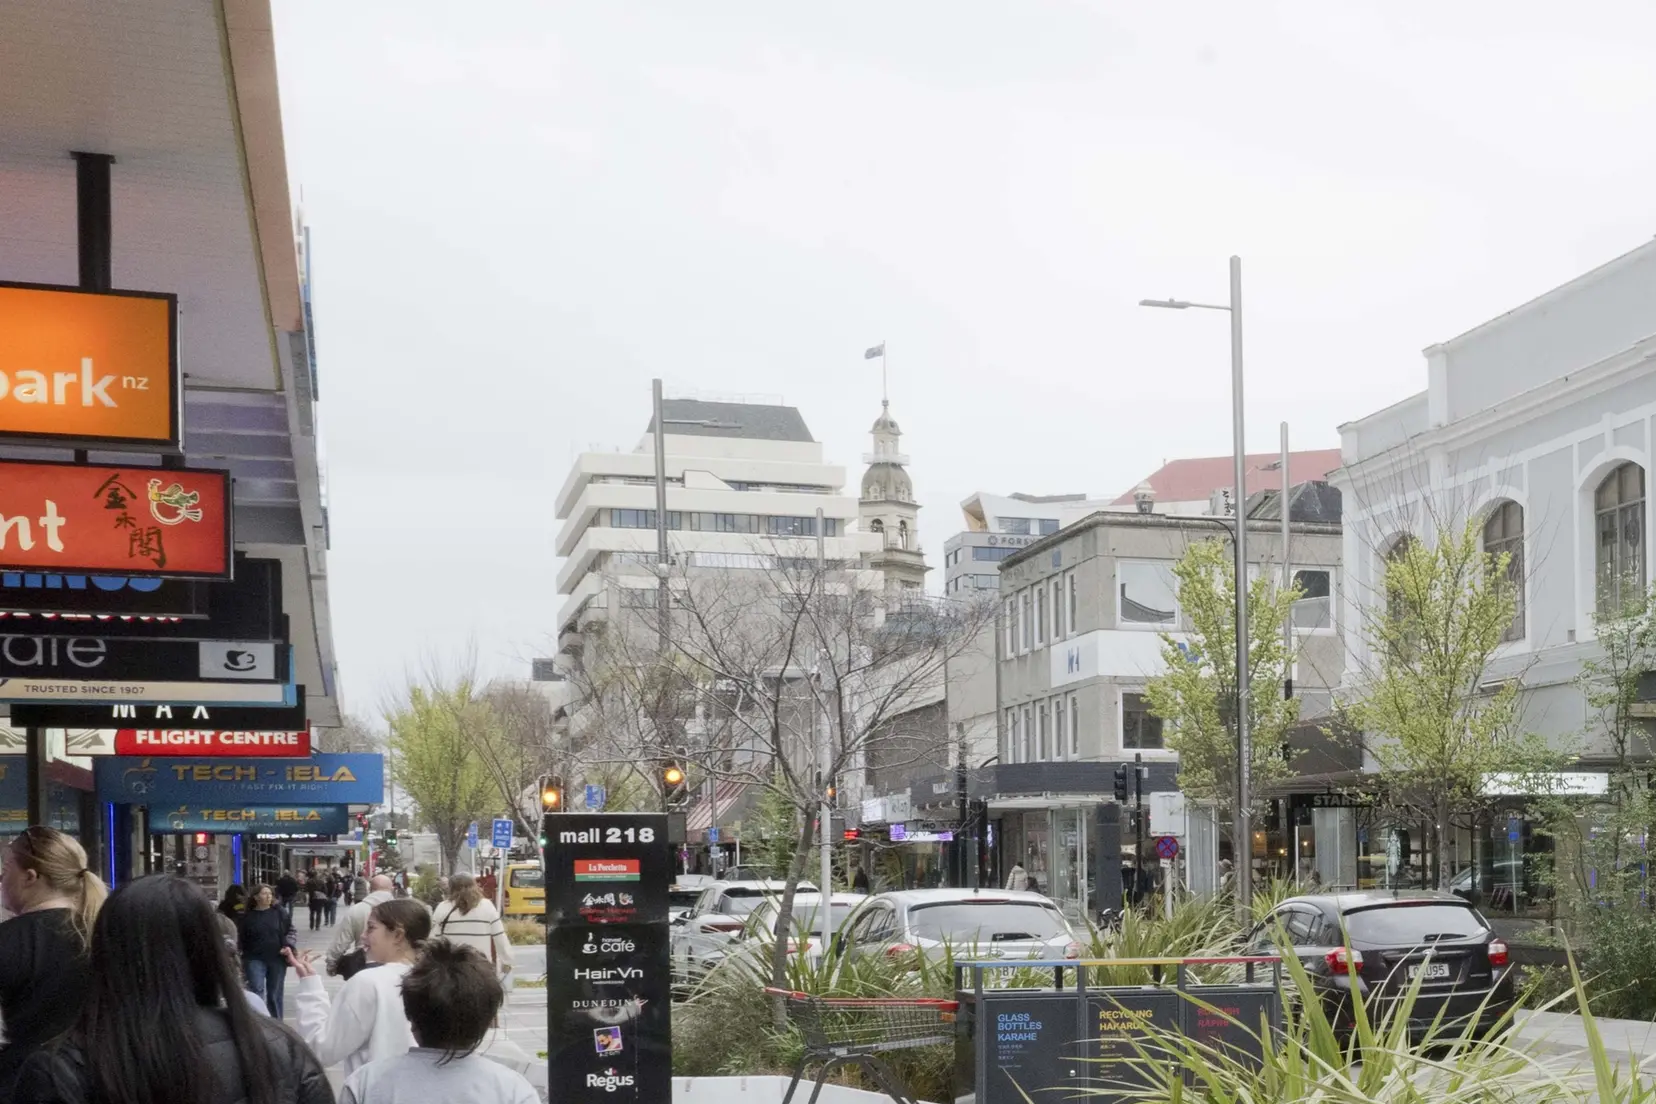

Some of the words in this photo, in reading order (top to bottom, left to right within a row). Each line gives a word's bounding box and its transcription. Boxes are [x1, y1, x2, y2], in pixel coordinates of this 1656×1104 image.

[121, 375, 150, 391] nz
[24, 684, 78, 694] TRUSTED
[81, 685, 116, 695] SINCE
[119, 686, 145, 695] 1907
[136, 730, 216, 745] FLIGHT
[219, 731, 299, 745] CENTRE
[171, 764, 258, 781] TECH
[200, 809, 256, 821] TECH
[560, 827, 600, 843] mall
[605, 827, 655, 843] 218
[588, 863, 597, 872] La
[600, 939, 636, 952] café
[574, 967, 644, 979] HairVn
[1413, 964, 1445, 977] U95
[572, 999, 632, 1008] DUNEDIN
[997, 1013, 1030, 1022] GLASS
[1099, 1010, 1153, 1019] RECYCING
[997, 1021, 1042, 1031] BOTTLES
[997, 1032, 1037, 1041] KARAHE
[586, 1073, 634, 1092] Regus
